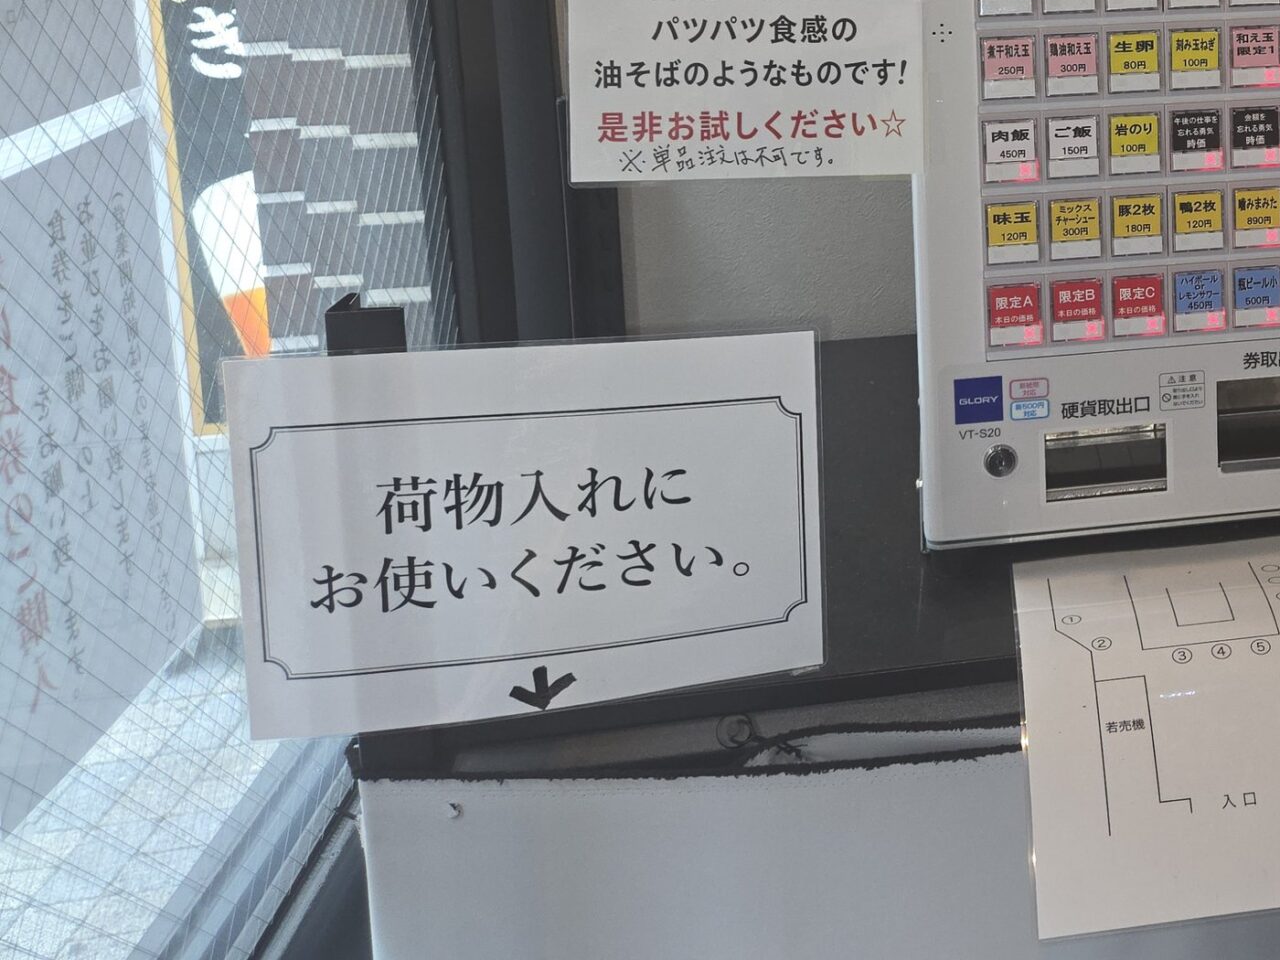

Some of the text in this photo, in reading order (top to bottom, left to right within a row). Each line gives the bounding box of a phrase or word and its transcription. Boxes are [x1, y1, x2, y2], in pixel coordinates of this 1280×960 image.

[651, 14, 858, 44] パツパツ食感の
[1236, 32, 1274, 44] 和え玉
[1114, 40, 1154, 53] 生卵
[1176, 37, 1216, 52] 刻み玉ねぎ
[987, 44, 1030, 59] 煮干和え玉
[1236, 46, 1275, 56] 限定1
[1060, 63, 1086, 72] 300円
[1123, 61, 1146, 70] 80円
[1183, 59, 1208, 67] 100円
[998, 66, 1024, 75] 250円
[991, 128, 1030, 142] 肉飯
[1054, 126, 1093, 138] ご飯
[1114, 123, 1152, 136] 岩のり
[1186, 139, 1206, 148] 時価
[1245, 135, 1265, 145] 時価
[1000, 149, 1026, 158] 450円
[1062, 146, 1088, 155] 150円
[1121, 144, 1146, 153] 100円
[1059, 204, 1092, 213] ミックス
[1118, 203, 1156, 217] 豚2枚
[993, 211, 1032, 225] 味玉
[1056, 214, 1095, 226] チャーシュー
[1186, 219, 1212, 228] 120円
[1247, 216, 1272, 225] 890円
[1062, 227, 1089, 236] 300円
[1126, 224, 1151, 233] 180円
[1001, 232, 1027, 241] 120円
[1238, 276, 1278, 291] 瓶ビール小
[1059, 289, 1095, 304] 限定B
[1119, 286, 1155, 301] 限定C
[995, 296, 1033, 310] 限定A
[1187, 301, 1213, 310] 450円
[1245, 296, 1270, 305] 500円
[959, 395, 1000, 406] GLORY
[1061, 396, 1151, 420] 硬貨取出口
[959, 427, 1001, 440] VT-S20
[376, 466, 692, 534] 荷物入れに
[310, 539, 750, 614] お使いください。
[1221, 792, 1257, 809] 入口
